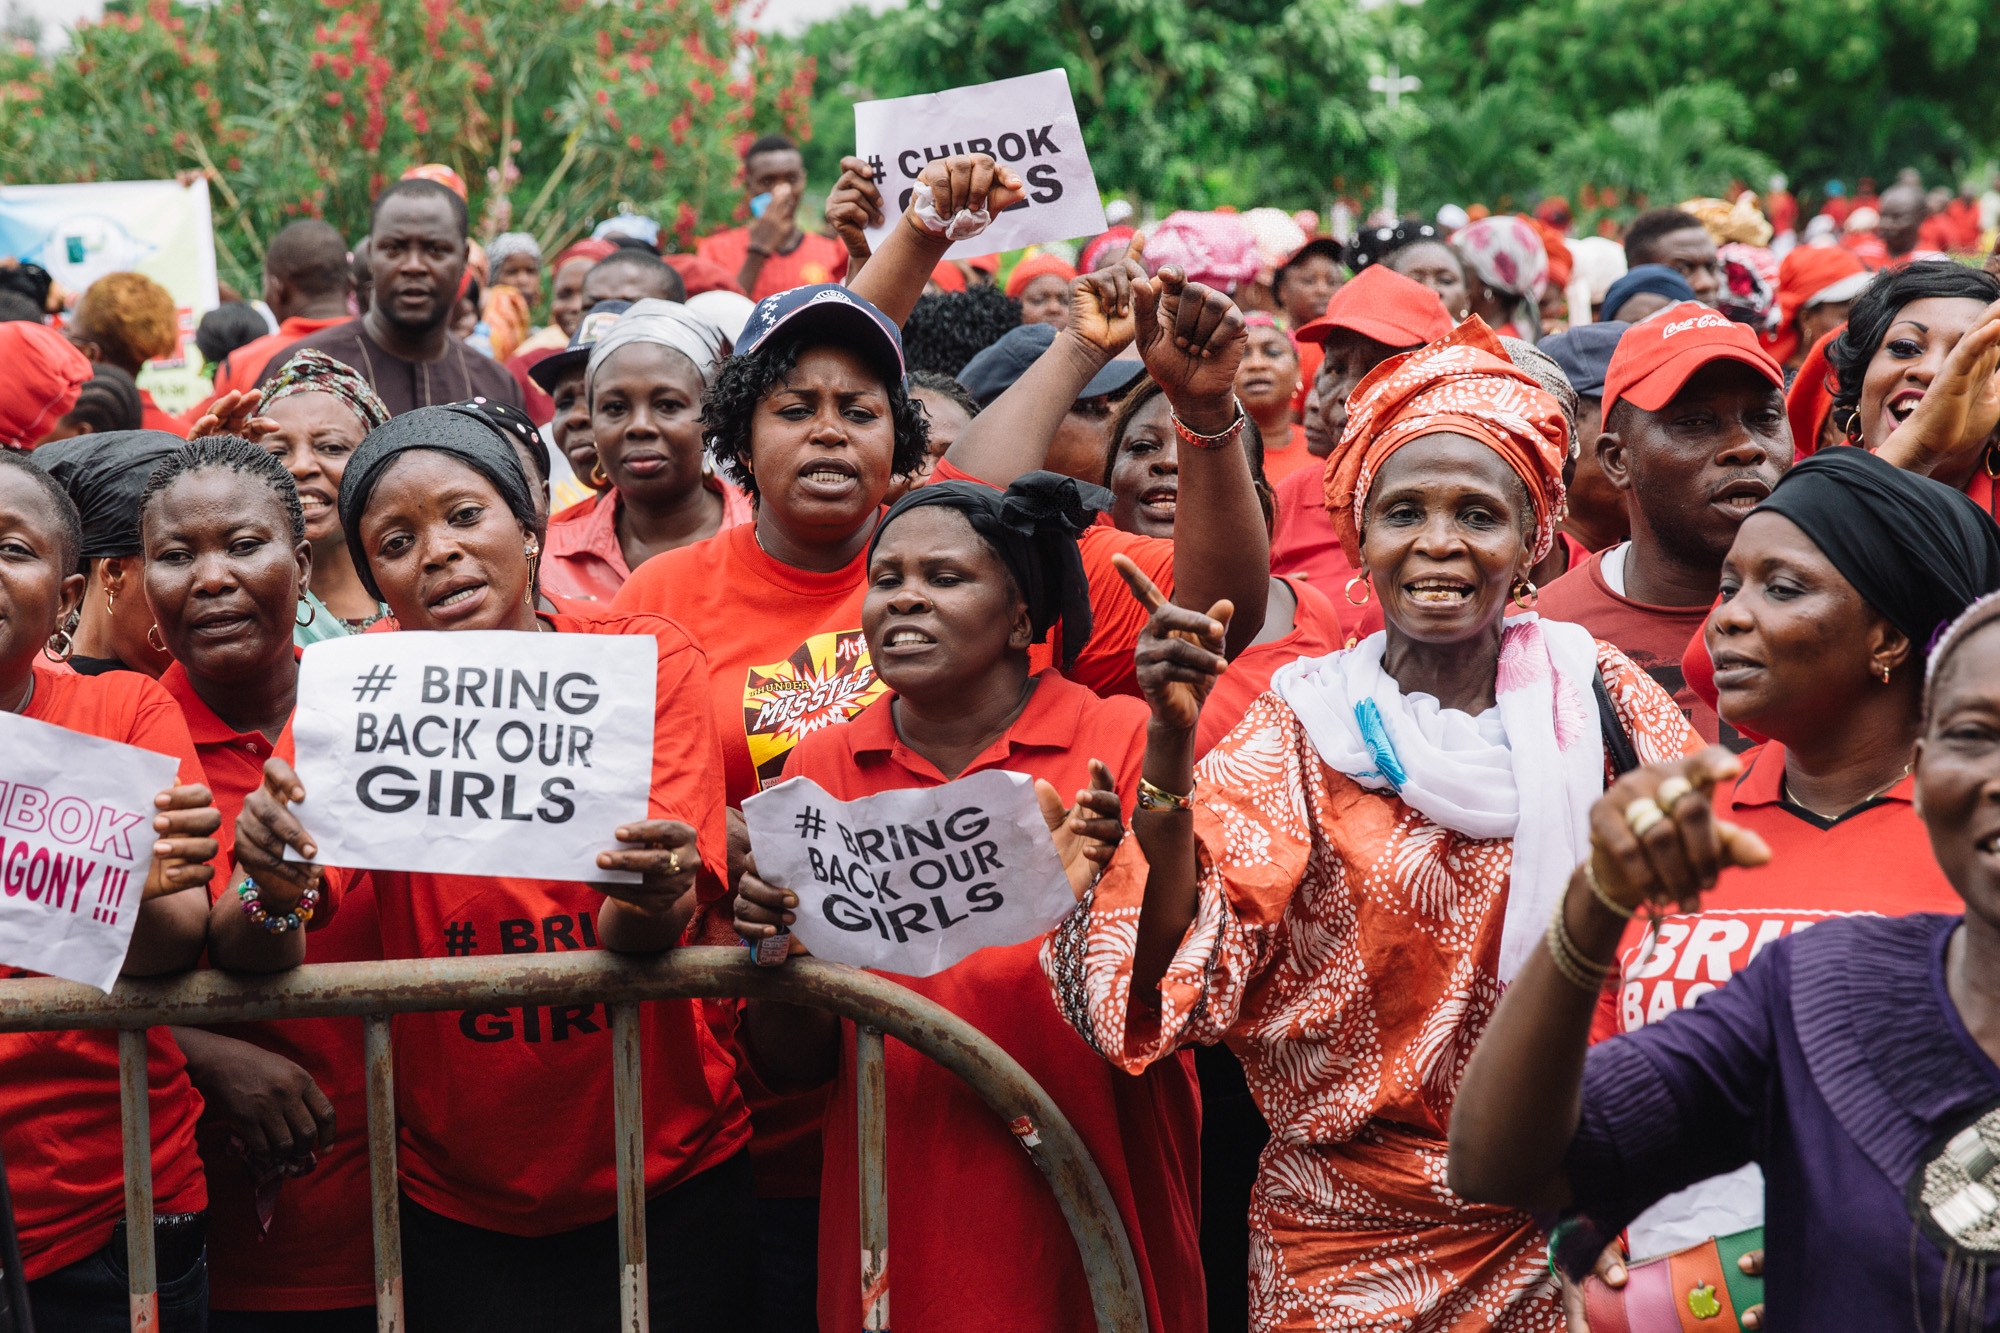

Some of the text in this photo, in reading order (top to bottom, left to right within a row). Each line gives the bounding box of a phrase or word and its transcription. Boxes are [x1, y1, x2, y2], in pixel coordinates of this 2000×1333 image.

[1663, 314, 1735, 339] Coca-Cola
[352, 664, 600, 715] # BRING
[749, 680, 810, 697] THUNDER
[752, 665, 874, 732] MISSILE
[354, 712, 594, 767] BACK OUR
[356, 765, 576, 824] GIRLS
[794, 805, 990, 865] # BRING
[0, 836, 96, 914] GONY
[808, 840, 1005, 904] BACK OUR
[444, 909, 600, 956] # BRI
[822, 882, 1004, 944] GIRLS
[1625, 919, 1816, 982] BRI
